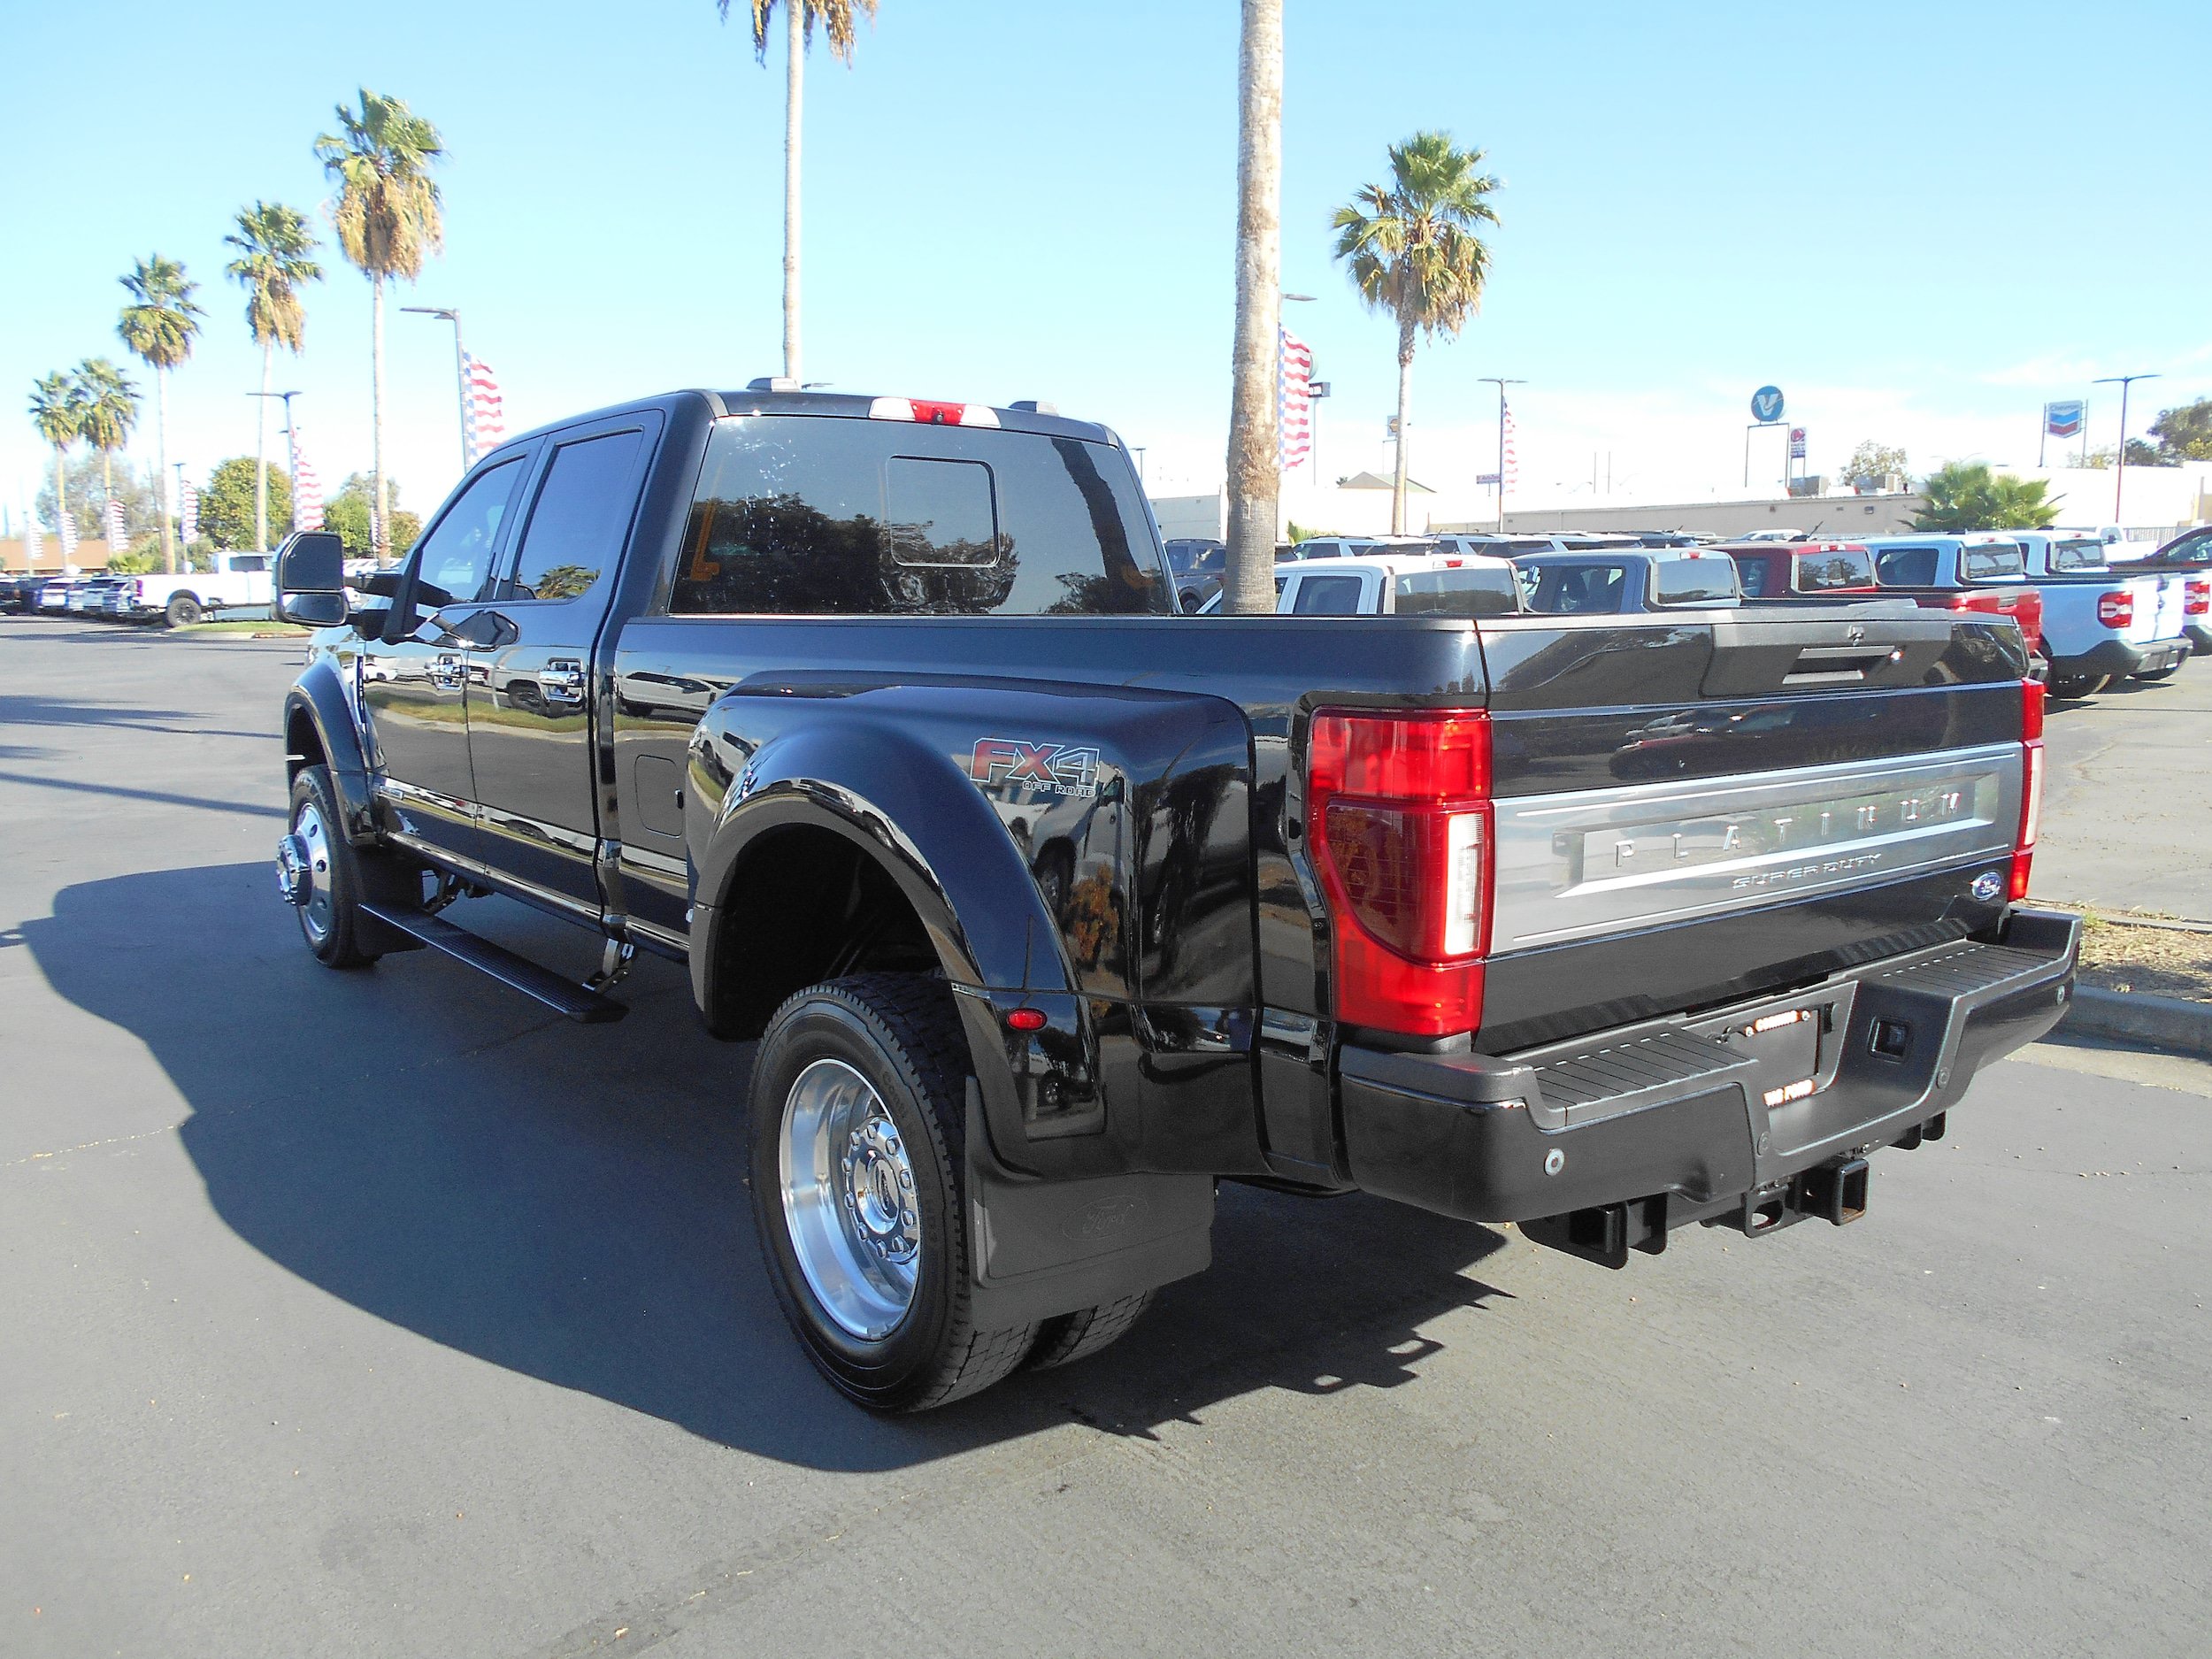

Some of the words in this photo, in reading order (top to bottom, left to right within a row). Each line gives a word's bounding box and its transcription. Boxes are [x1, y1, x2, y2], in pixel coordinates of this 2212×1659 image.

[970, 737, 1100, 788] FX4
[1022, 780, 1051, 794] OFF
[1055, 784, 1096, 797] ROAD
[1616, 792, 1962, 867] PLATINUM
[1732, 864, 1819, 889] SUPER
[1823, 853, 1882, 873] DUTY
